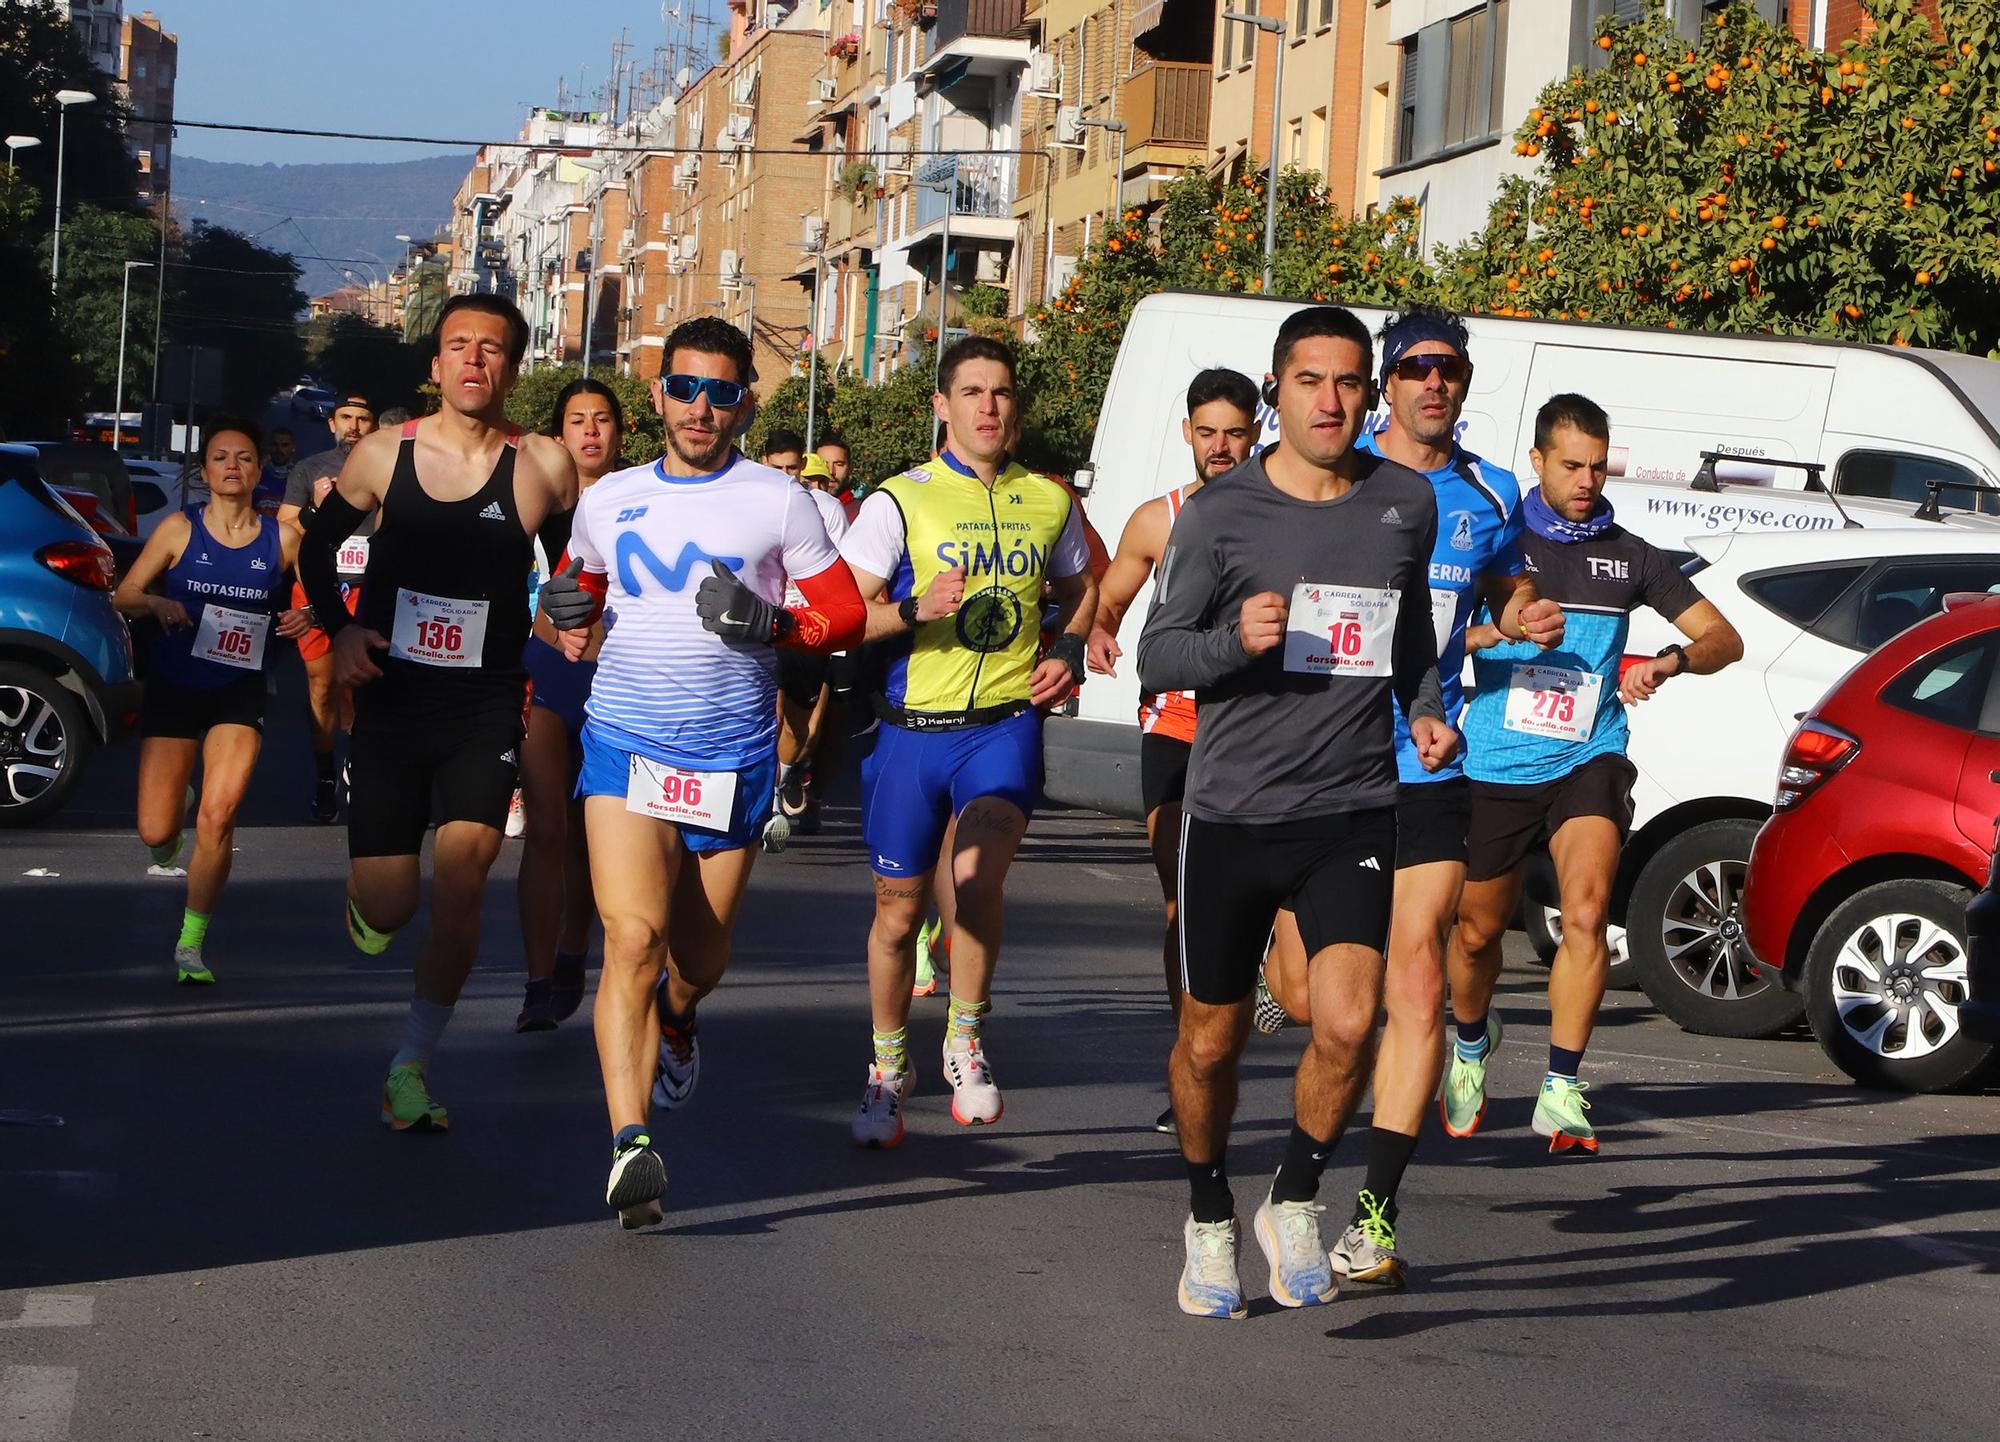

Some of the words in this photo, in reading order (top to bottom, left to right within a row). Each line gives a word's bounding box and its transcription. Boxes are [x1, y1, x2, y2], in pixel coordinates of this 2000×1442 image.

[1716, 443, 1765, 457] Después
[1635, 466, 1676, 481] Conducto
[1677, 469, 1686, 481] de
[479, 511, 506, 521] adidas
[1647, 498, 1834, 530] www.geyse.com
[956, 522, 998, 531] PATATAS
[1001, 522, 1031, 532] FRITAS
[340, 550, 365, 566] 186
[187, 579, 269, 600] TROTASIERRA
[1324, 590, 1362, 599] CARRERA
[420, 597, 452, 608] CARRERA
[441, 607, 478, 616] SOLIDARIA
[217, 629, 252, 656] 105
[416, 620, 463, 652] 136
[1328, 622, 1362, 656] 16
[407, 645, 465, 660] dorsalia.com
[1305, 654, 1375, 667] dorsalia.com
[1537, 669, 1568, 678] CARRERA
[1531, 688, 1576, 723] 273
[928, 716, 966, 726] Kalenji
[662, 775, 703, 807] 96
[646, 801, 712, 819] dorsalia.com
